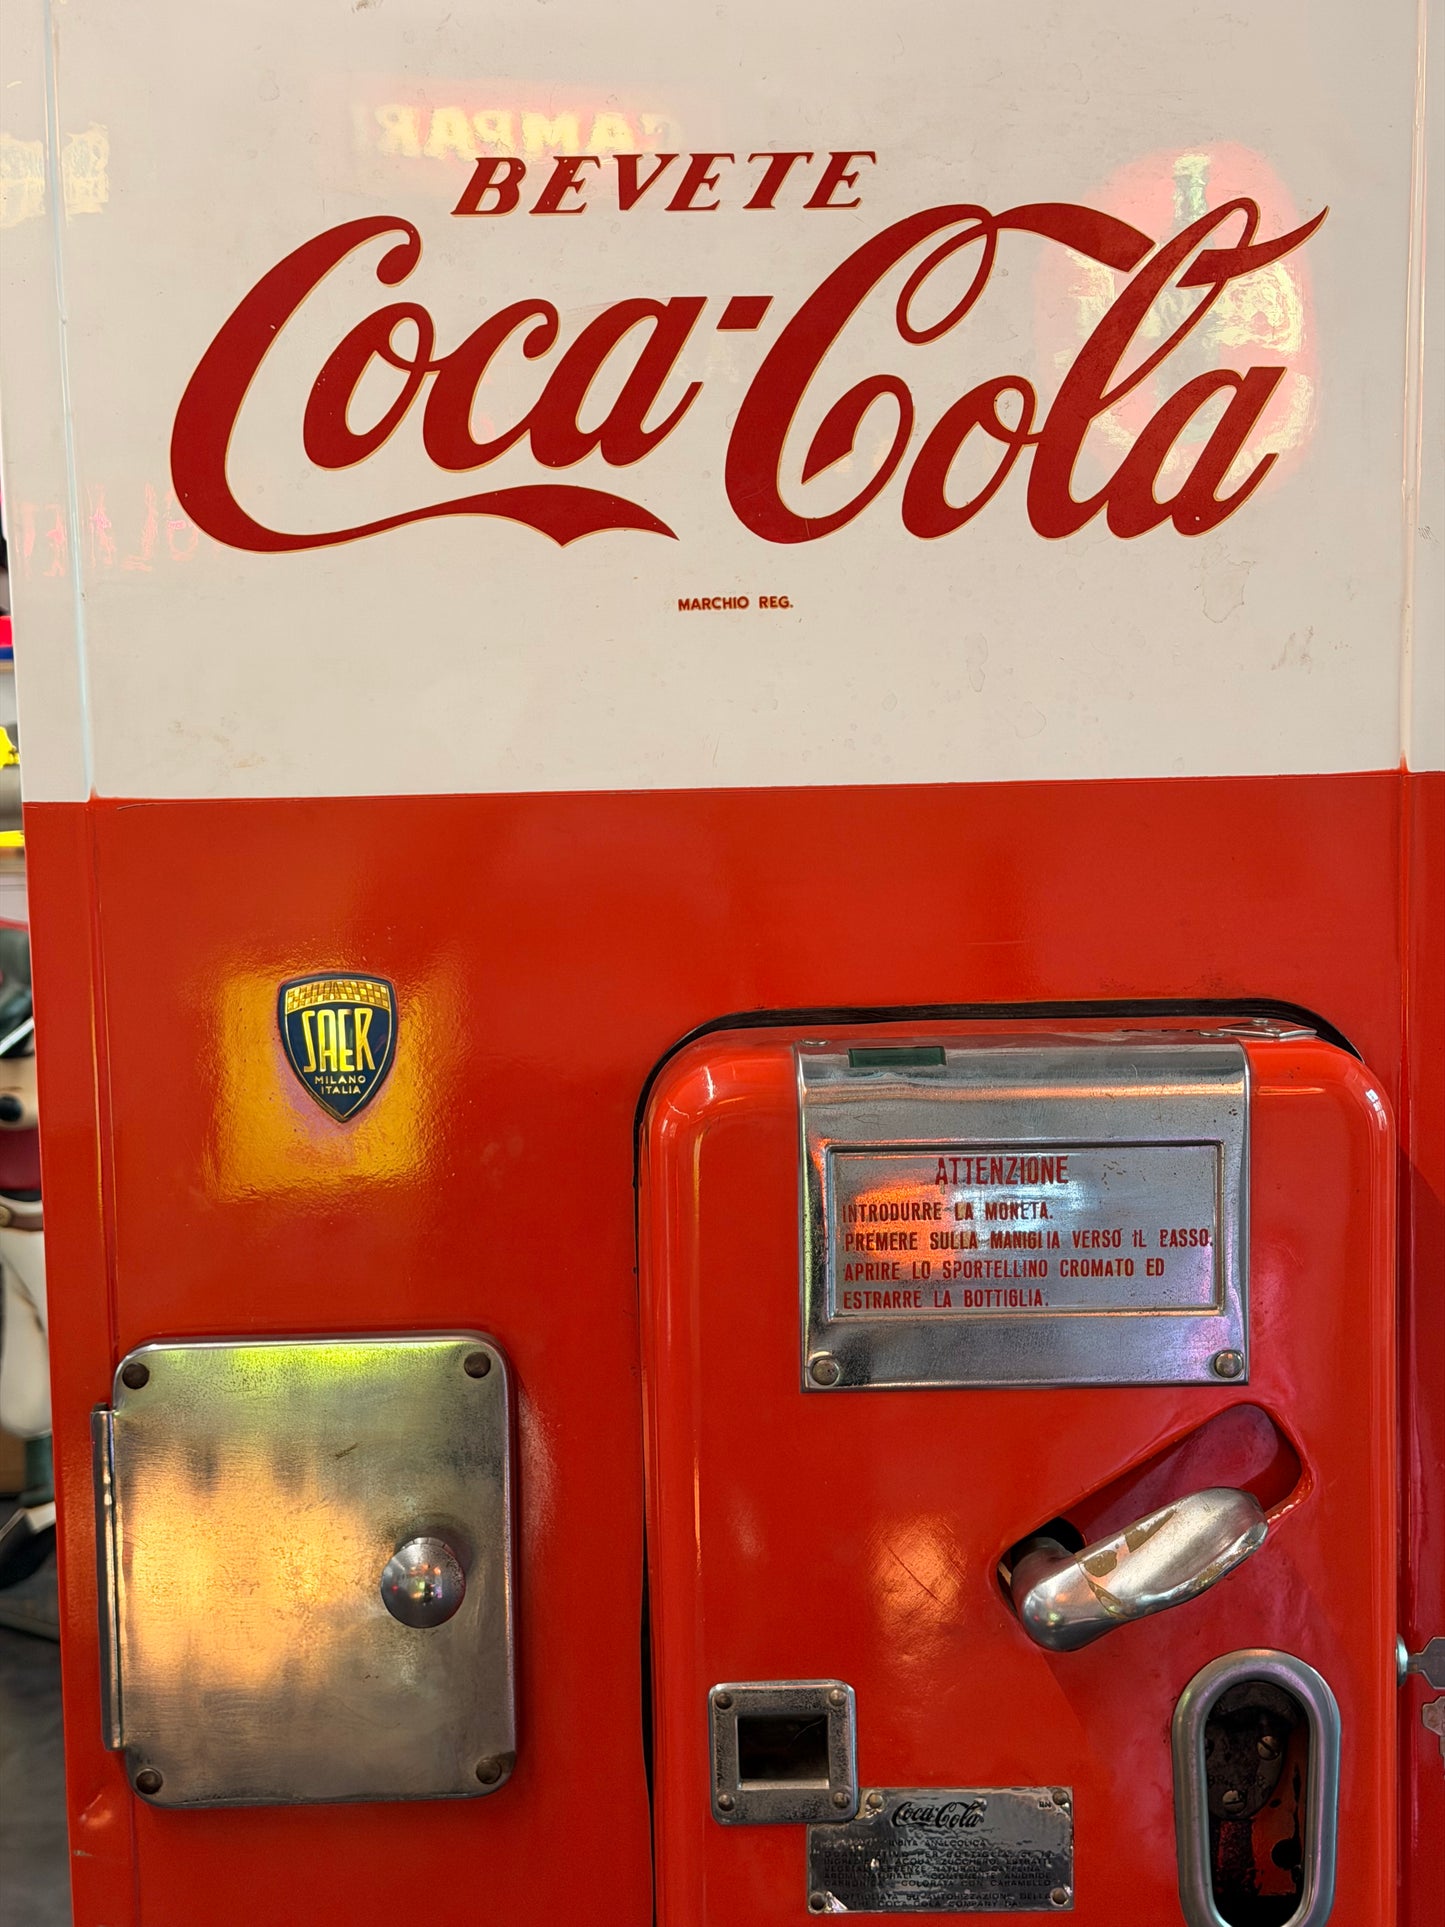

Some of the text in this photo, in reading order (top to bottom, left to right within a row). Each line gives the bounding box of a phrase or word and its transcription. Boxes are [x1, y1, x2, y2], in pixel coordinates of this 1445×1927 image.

[453, 152, 879, 216] BEVETE
[170, 197, 1329, 552] Coca-Cola
[678, 595, 795, 611] MARCHIO REG.
[302, 1007, 376, 1073] SAER
[314, 1074, 367, 1085] MILANO
[321, 1085, 361, 1095] ITALIA
[935, 1156, 1070, 1185] ATTENZIONE
[842, 1201, 1054, 1223] INTRODURRE LA MONETA.
[845, 1231, 918, 1252] PREMERE
[930, 1231, 978, 1250] SULLA
[990, 1230, 1061, 1250] MANIGLIA
[1072, 1228, 1122, 1249] VERSO
[1132, 1229, 1147, 1248] IL
[844, 1257, 1165, 1282] APRIRE LO SPORTELLINO CROMATO ED
[843, 1288, 1050, 1310] ESTRARRE LA BOTTIGLIA.
[890, 1801, 986, 1829] Coca-Cola
